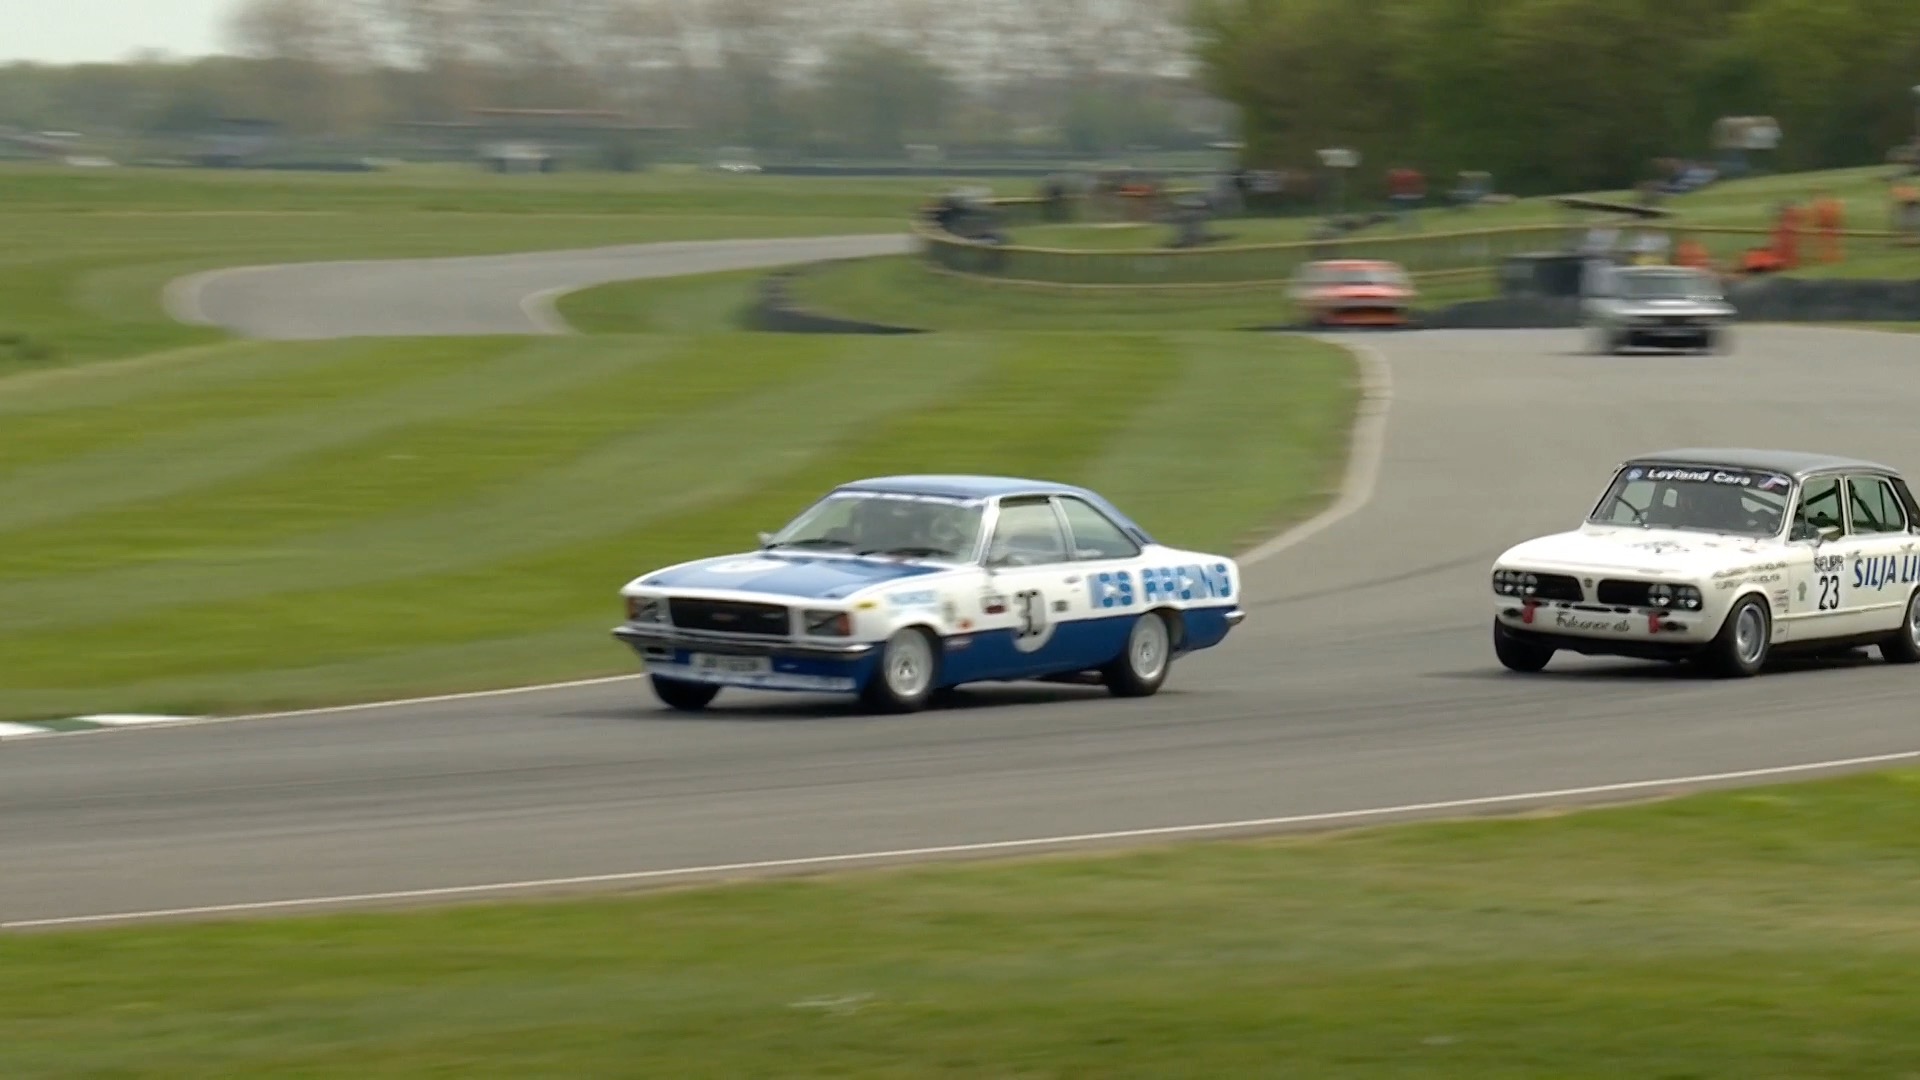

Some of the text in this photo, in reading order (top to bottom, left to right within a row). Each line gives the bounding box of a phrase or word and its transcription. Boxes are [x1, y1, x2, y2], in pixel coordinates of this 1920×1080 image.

[1648, 469, 1751, 486] Leyland Cars
[1853, 555, 1920, 592] SILJA LI
[1819, 575, 1839, 610] 23
